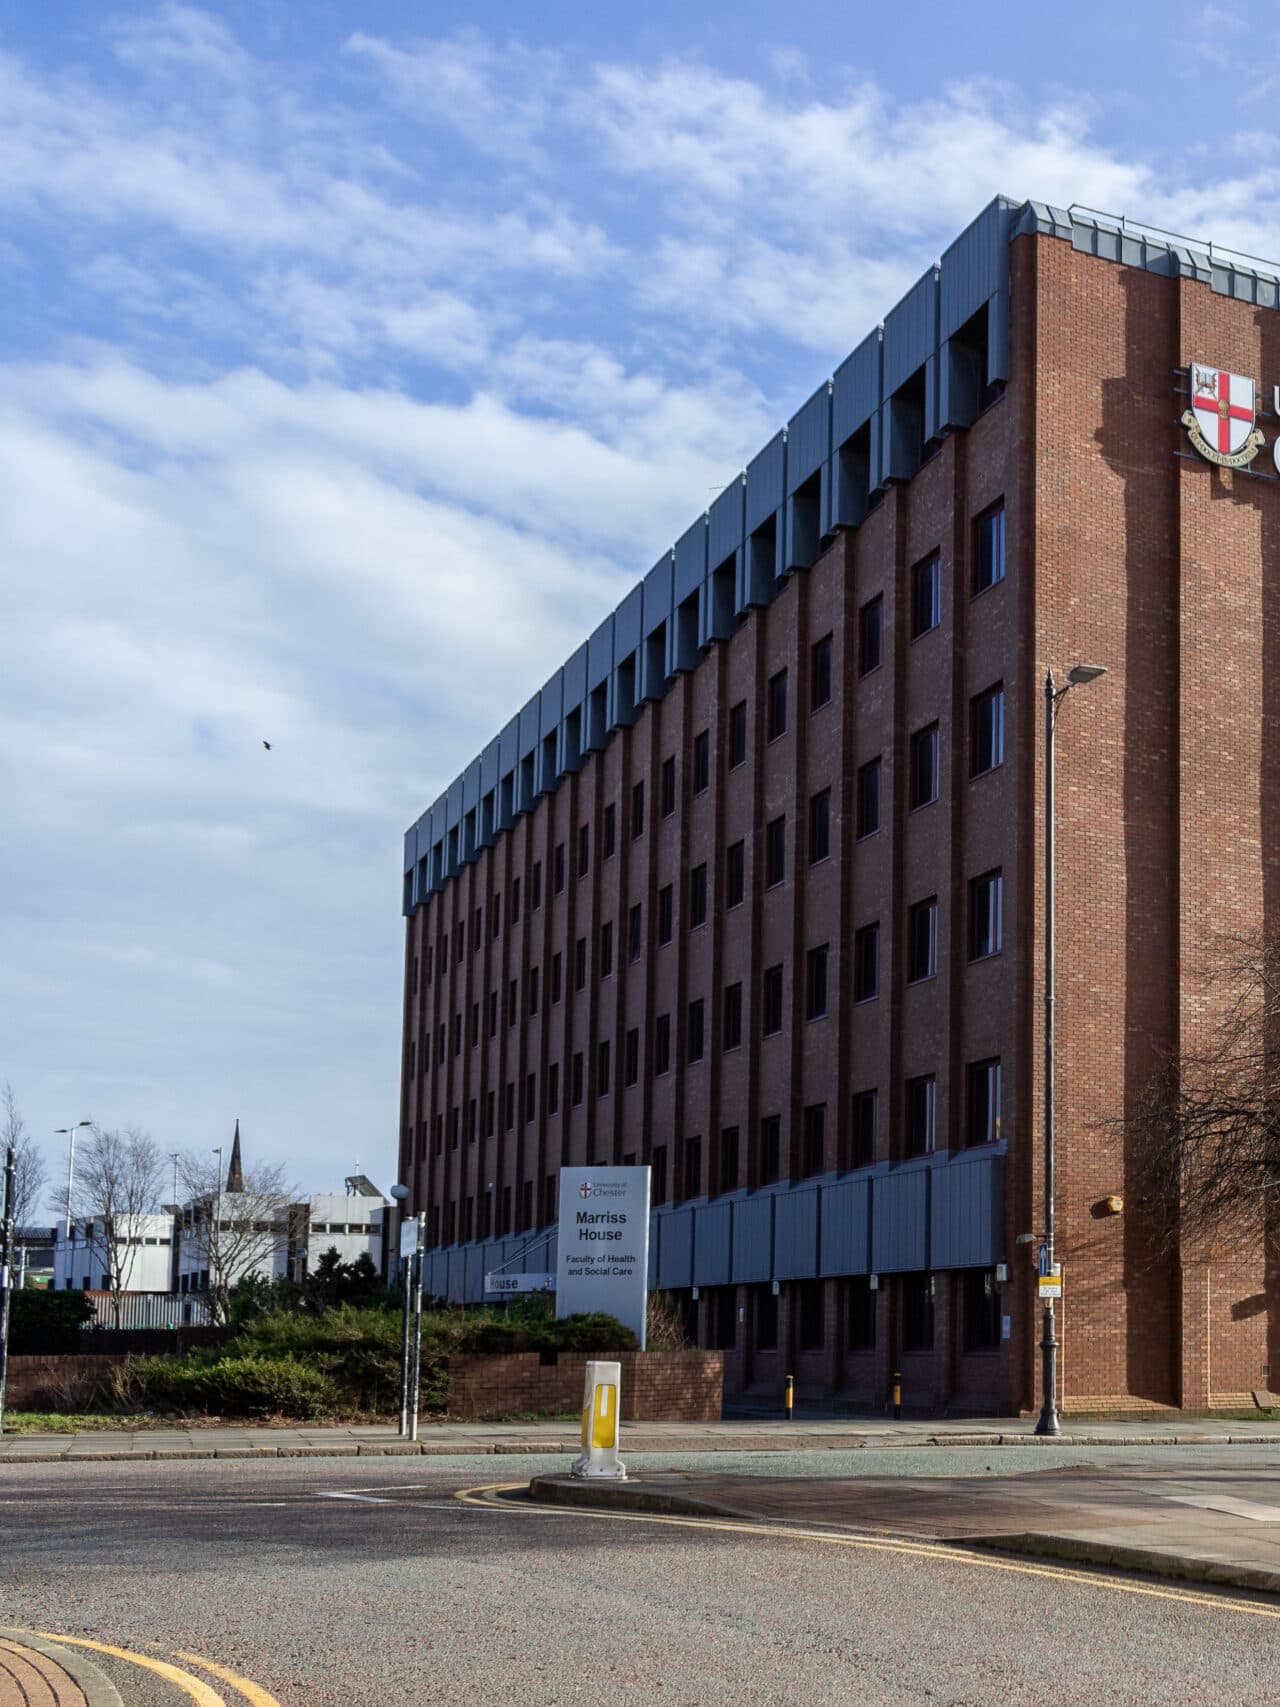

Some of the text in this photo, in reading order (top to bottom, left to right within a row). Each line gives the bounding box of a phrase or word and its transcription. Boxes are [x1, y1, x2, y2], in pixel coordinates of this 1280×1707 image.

[593, 1188, 627, 1198] Chester
[576, 1210, 627, 1224] Marriss
[579, 1228, 623, 1241] House
[566, 1254, 636, 1265] Faculty of Health
[567, 1267, 633, 1276] and Social Care
